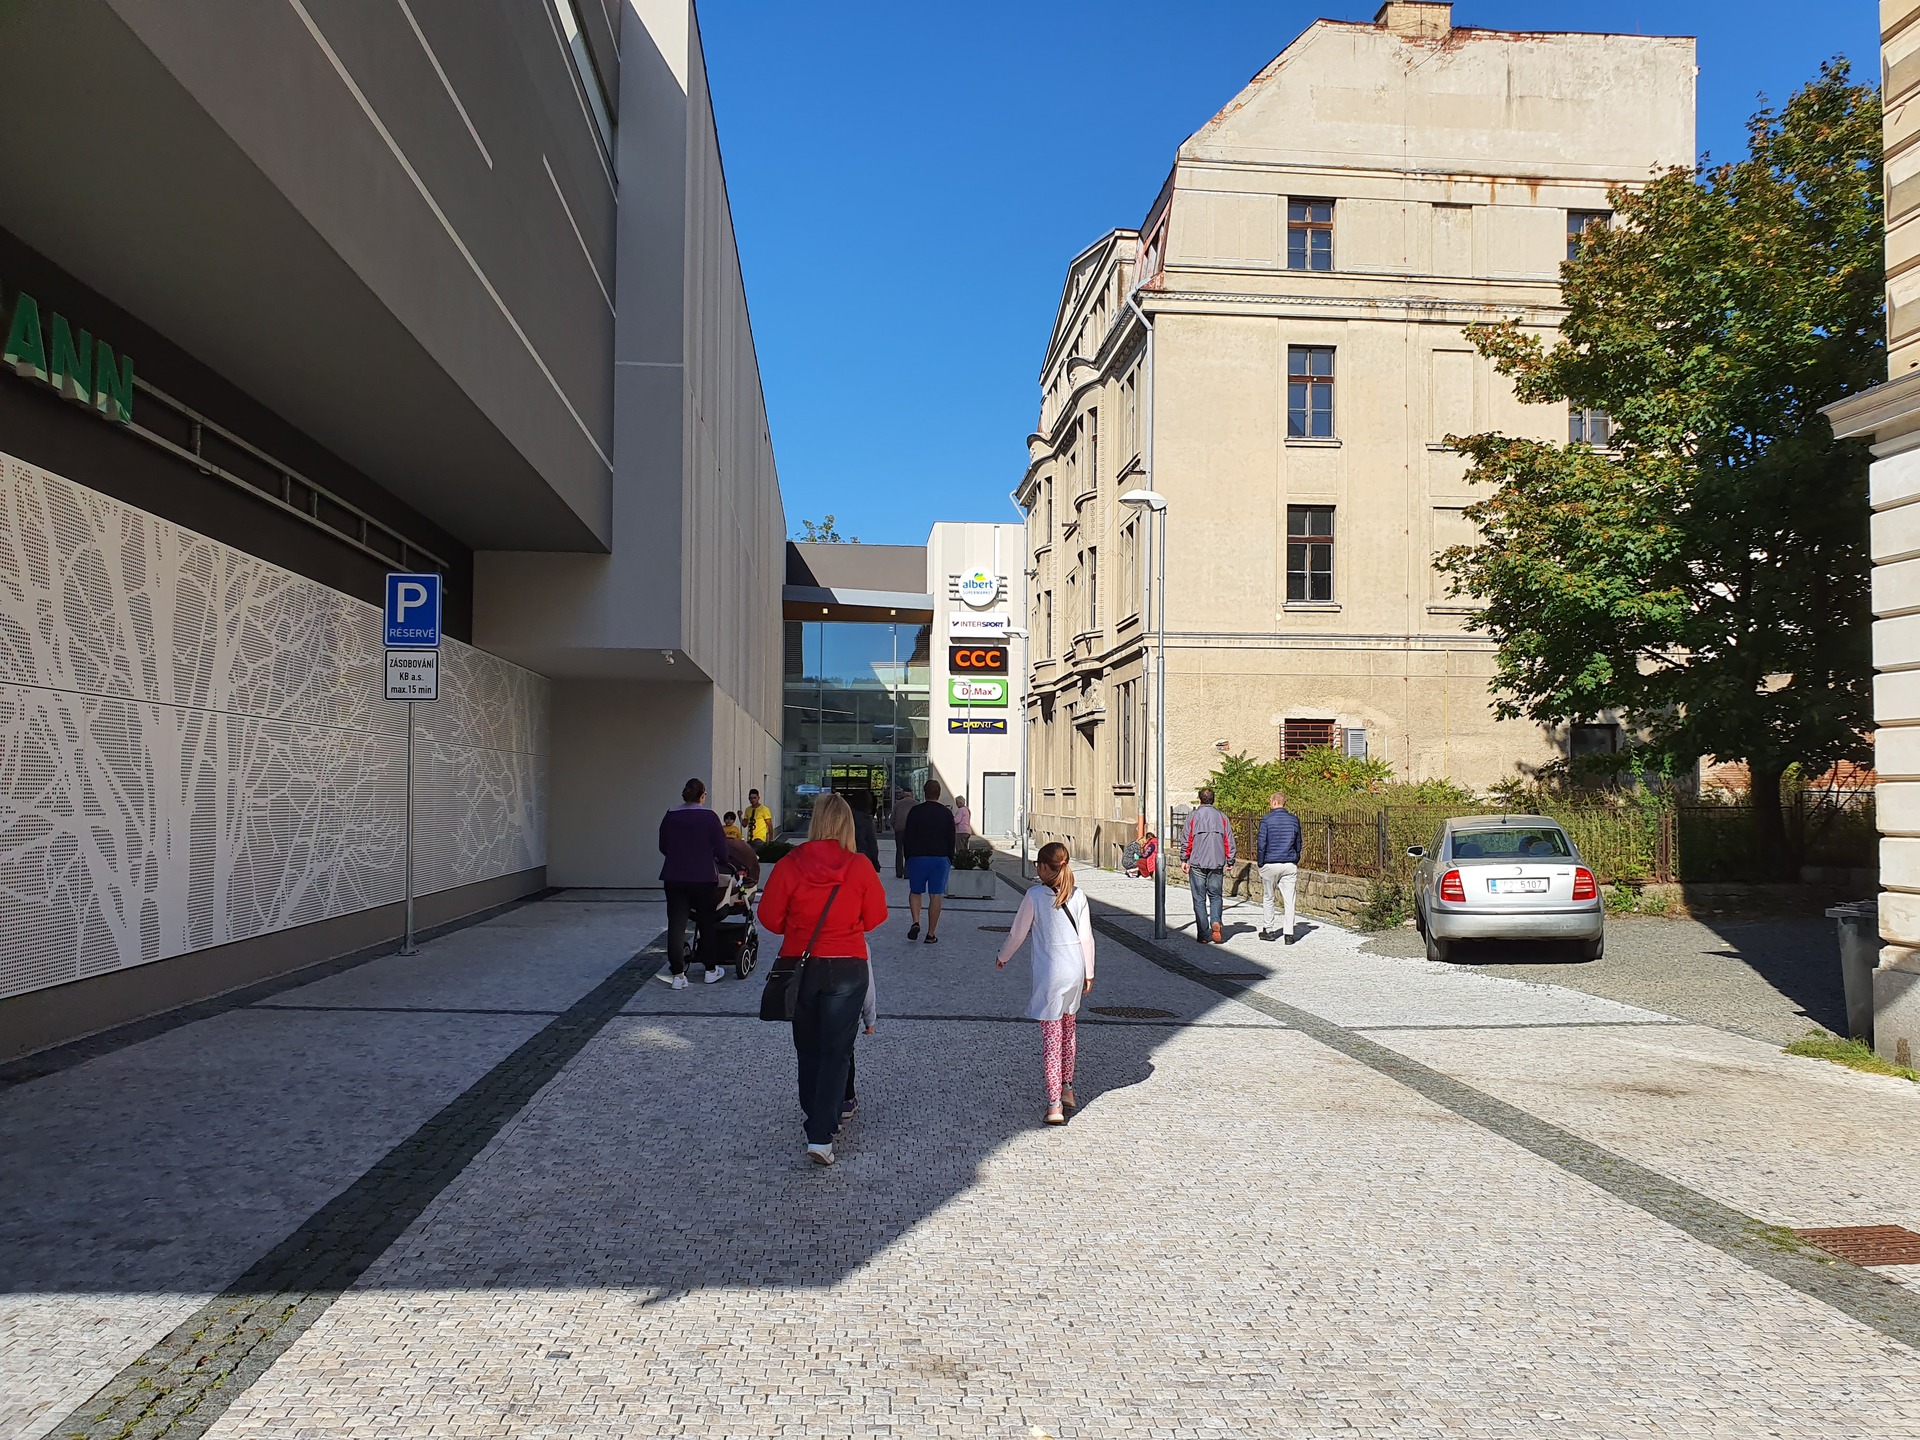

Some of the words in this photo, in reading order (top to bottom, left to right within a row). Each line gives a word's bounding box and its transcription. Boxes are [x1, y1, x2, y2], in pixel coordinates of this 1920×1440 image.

[3, 291, 134, 425] ANN
[962, 580, 994, 589] albert
[396, 582, 428, 623] P
[389, 627, 435, 638] RÉSERVÉ
[389, 657, 434, 669] ZÁSOBOVÁNÍ
[955, 650, 1001, 668] CCC
[399, 672, 409, 681] KB
[418, 685, 432, 694] min
[1520, 880, 1542, 889] 5107
